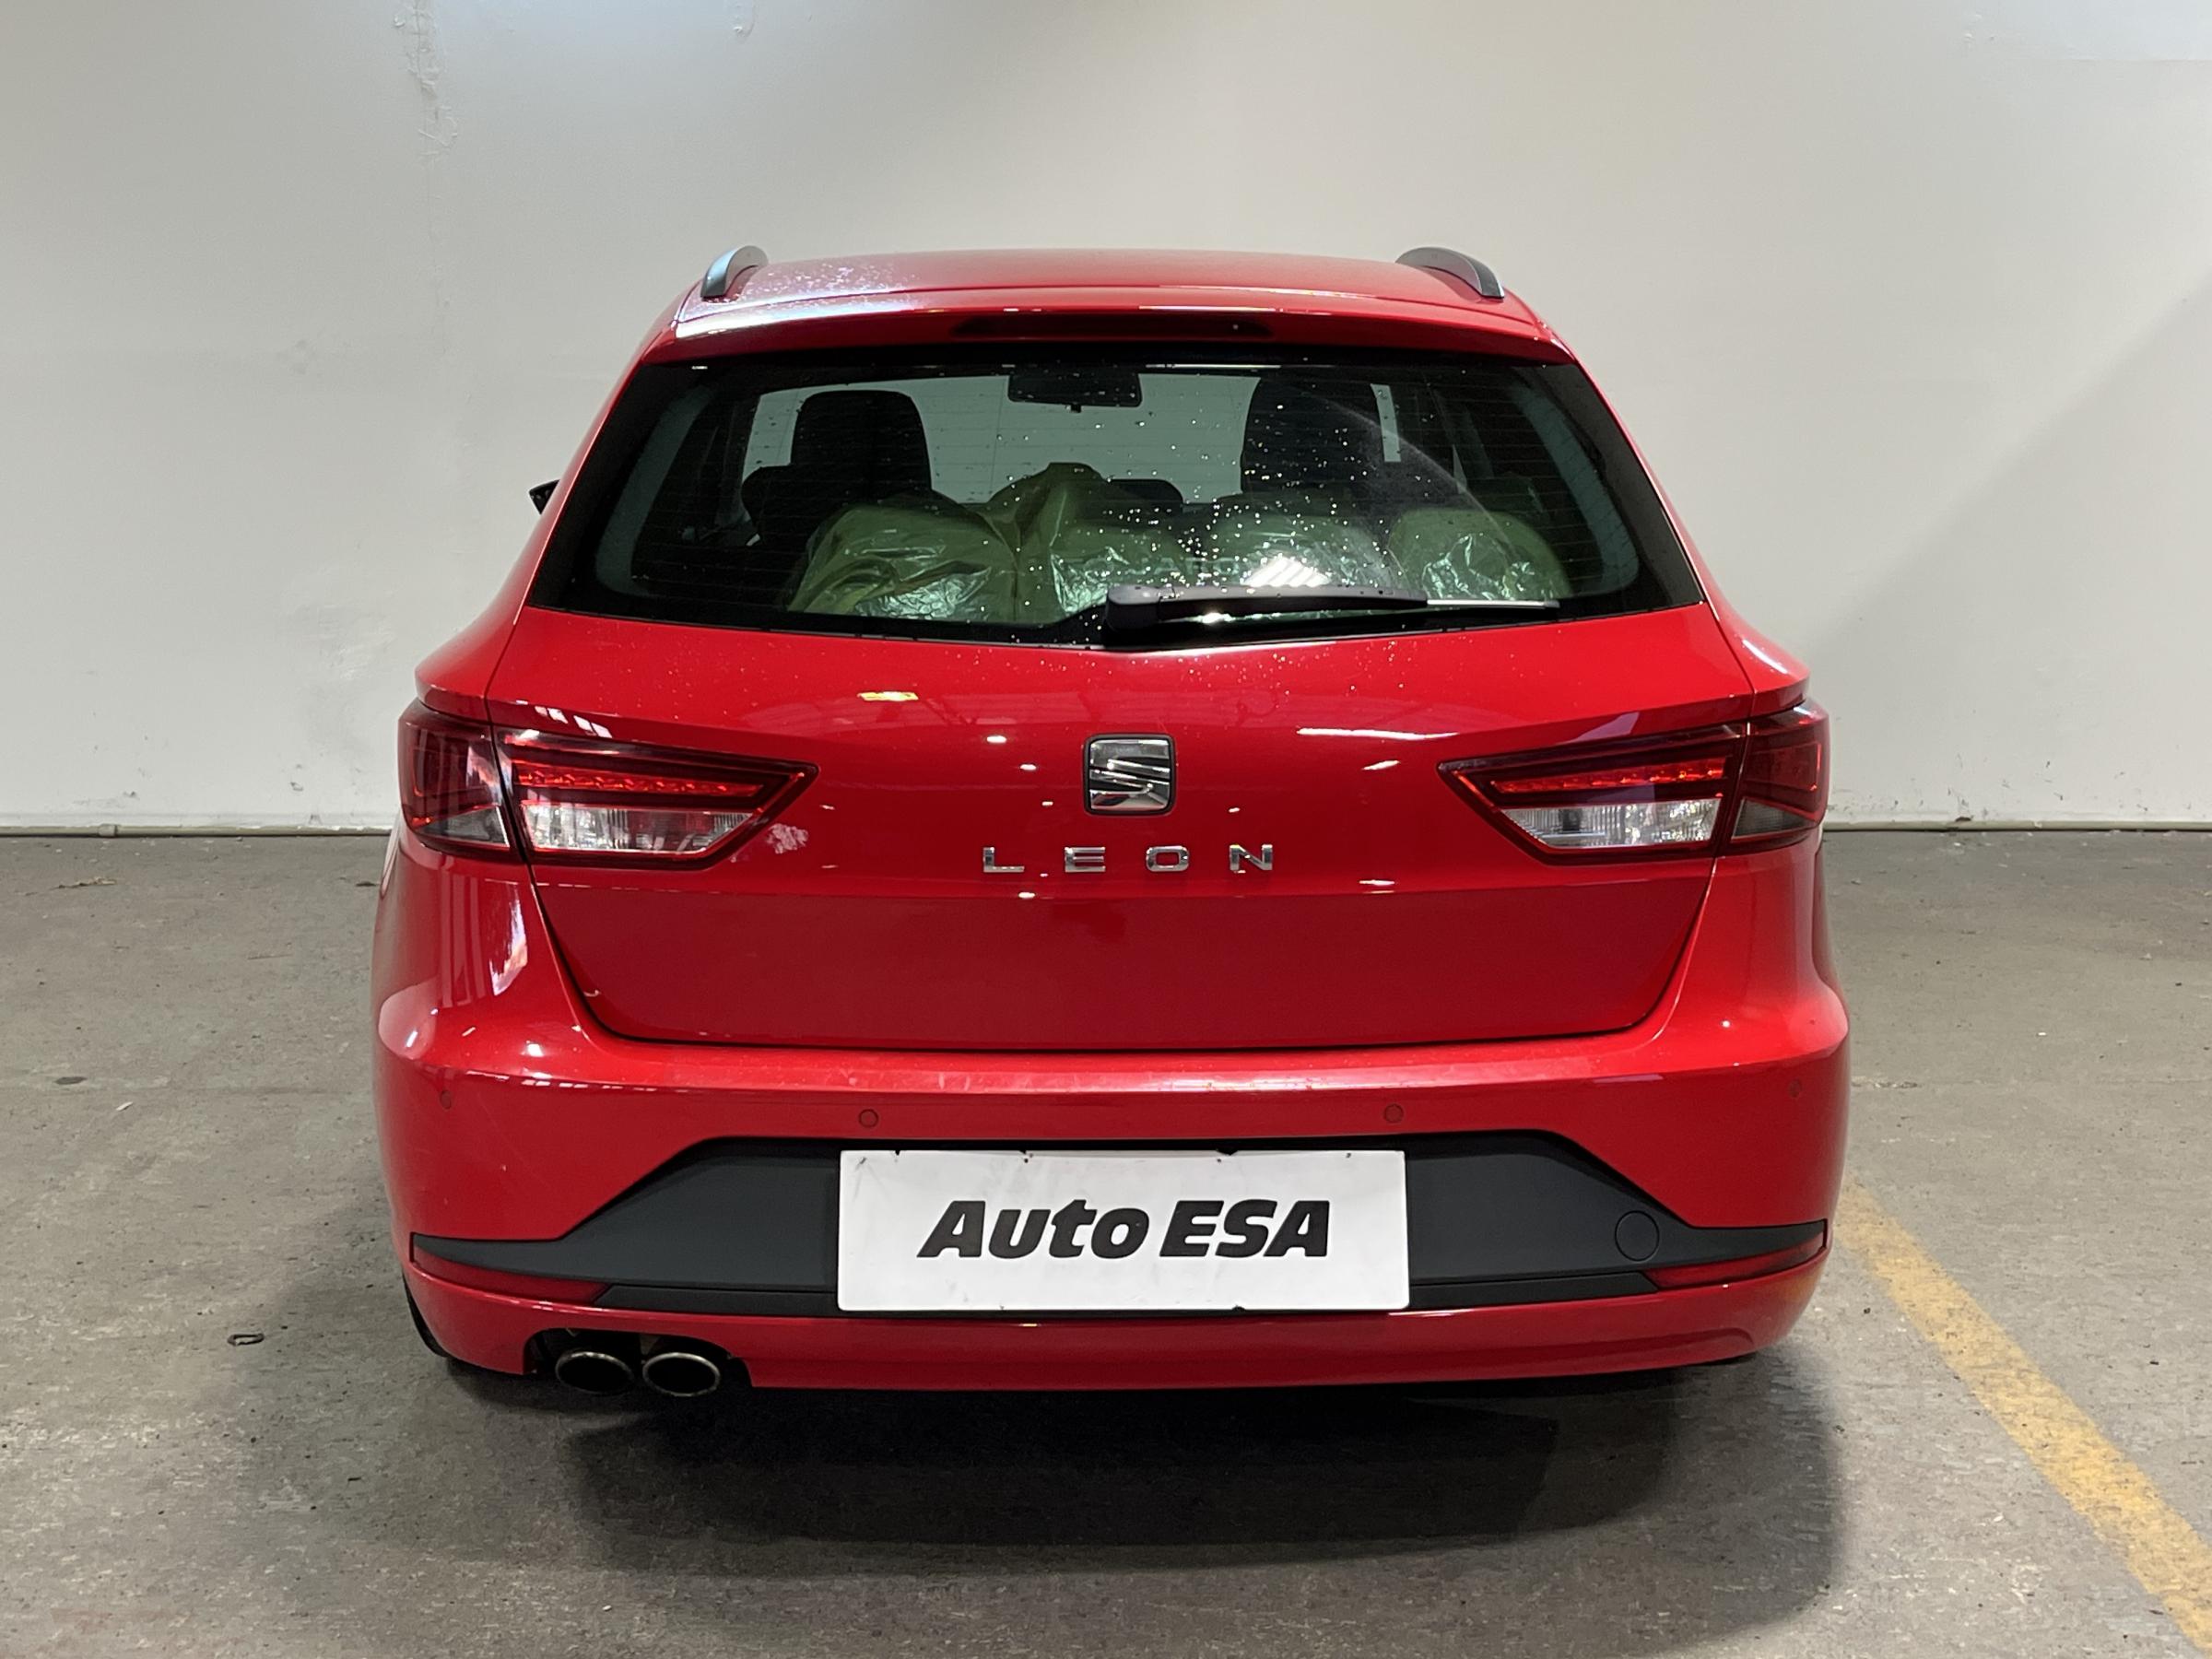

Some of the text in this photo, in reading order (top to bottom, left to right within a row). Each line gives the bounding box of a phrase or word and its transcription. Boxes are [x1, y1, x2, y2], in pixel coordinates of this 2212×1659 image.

[982, 844, 1274, 873] LEON
[916, 1198, 1331, 1260] Auto ESA
